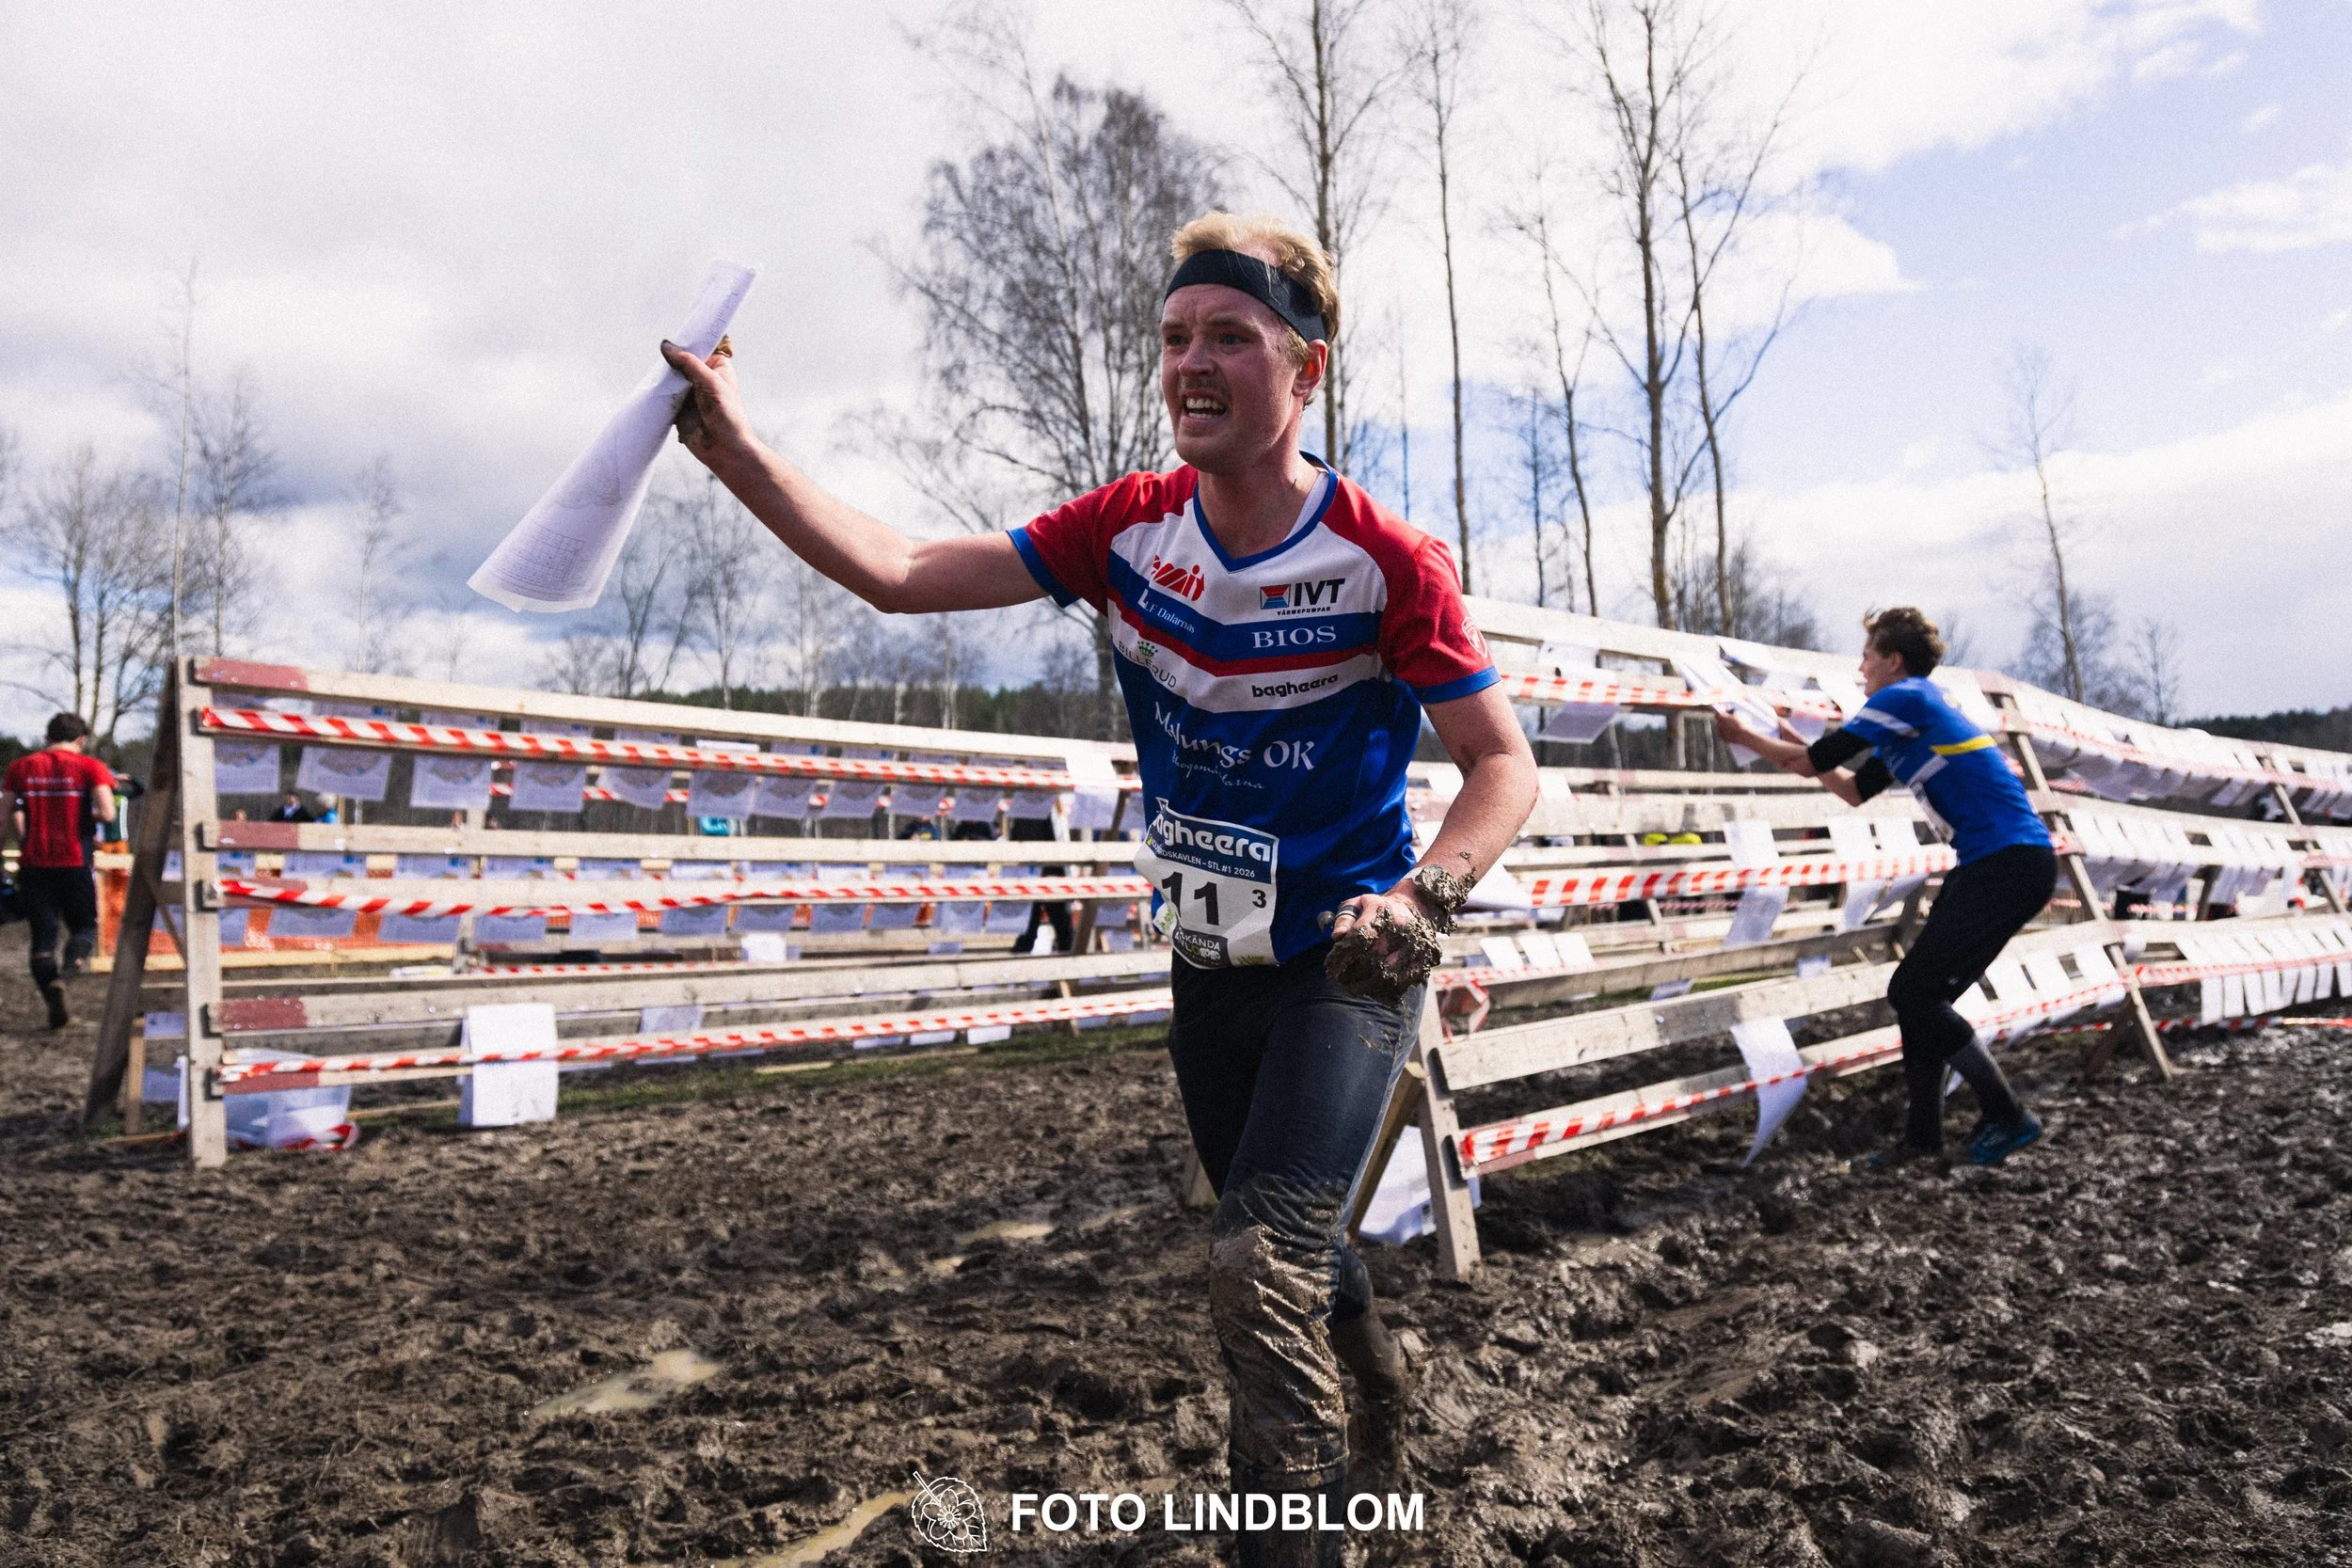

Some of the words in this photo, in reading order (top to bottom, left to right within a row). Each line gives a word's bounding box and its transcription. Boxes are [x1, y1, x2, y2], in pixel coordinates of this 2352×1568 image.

[1294, 578, 1346, 608] IVT
[1157, 607, 1196, 634] Dalarnas
[1251, 626, 1337, 649] BIOS
[1119, 641, 1177, 689] BILLERUD
[1251, 673, 1339, 698] bagheera
[1263, 739, 1315, 771] OK
[1207, 860, 1221, 871] STL
[1221, 864, 1232, 874] #1
[1233, 866, 1256, 879] 2026
[1161, 871, 1220, 927] 11
[1251, 889, 1267, 909] 3
